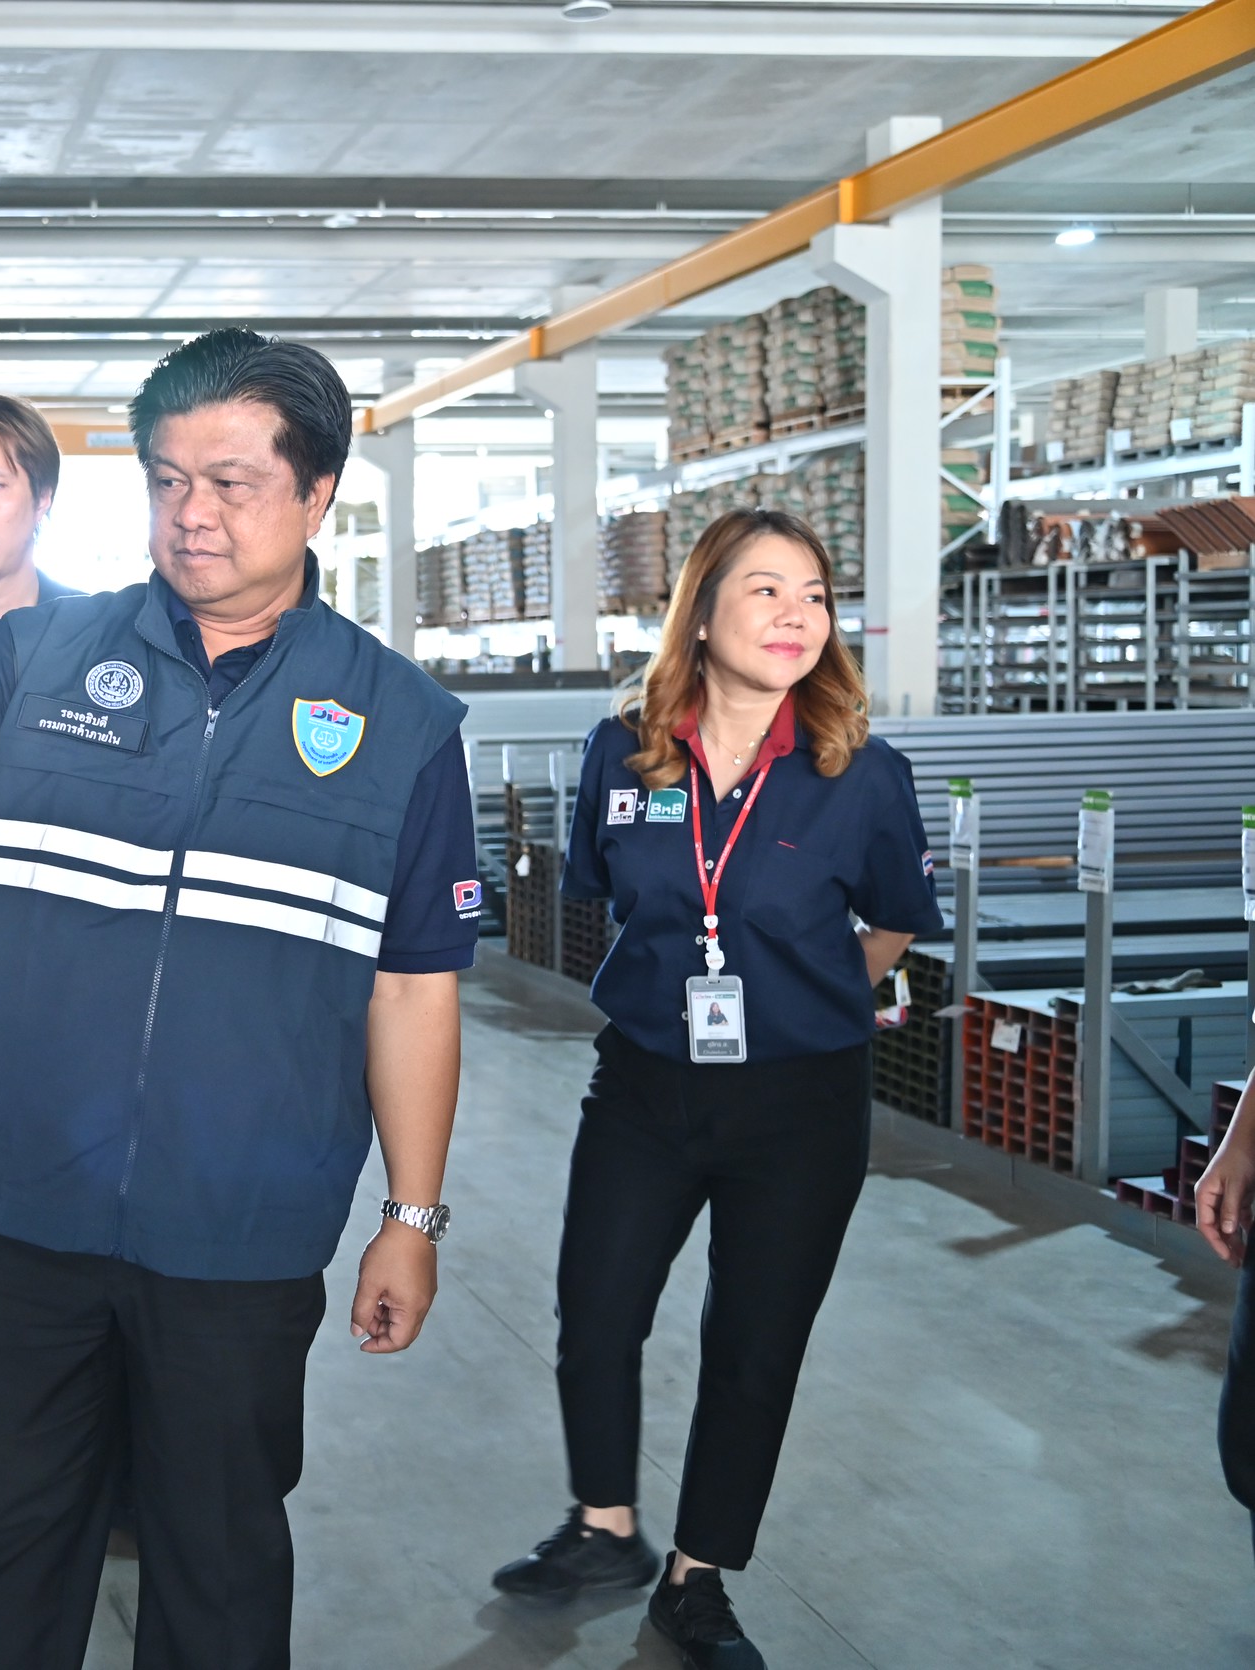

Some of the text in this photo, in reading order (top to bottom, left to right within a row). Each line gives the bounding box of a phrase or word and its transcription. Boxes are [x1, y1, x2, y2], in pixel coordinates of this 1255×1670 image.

[60, 708, 109, 728] รองอธิบดี
[39, 718, 121, 745] กรมการค้าภายใน
[650, 802, 683, 815] BnB
